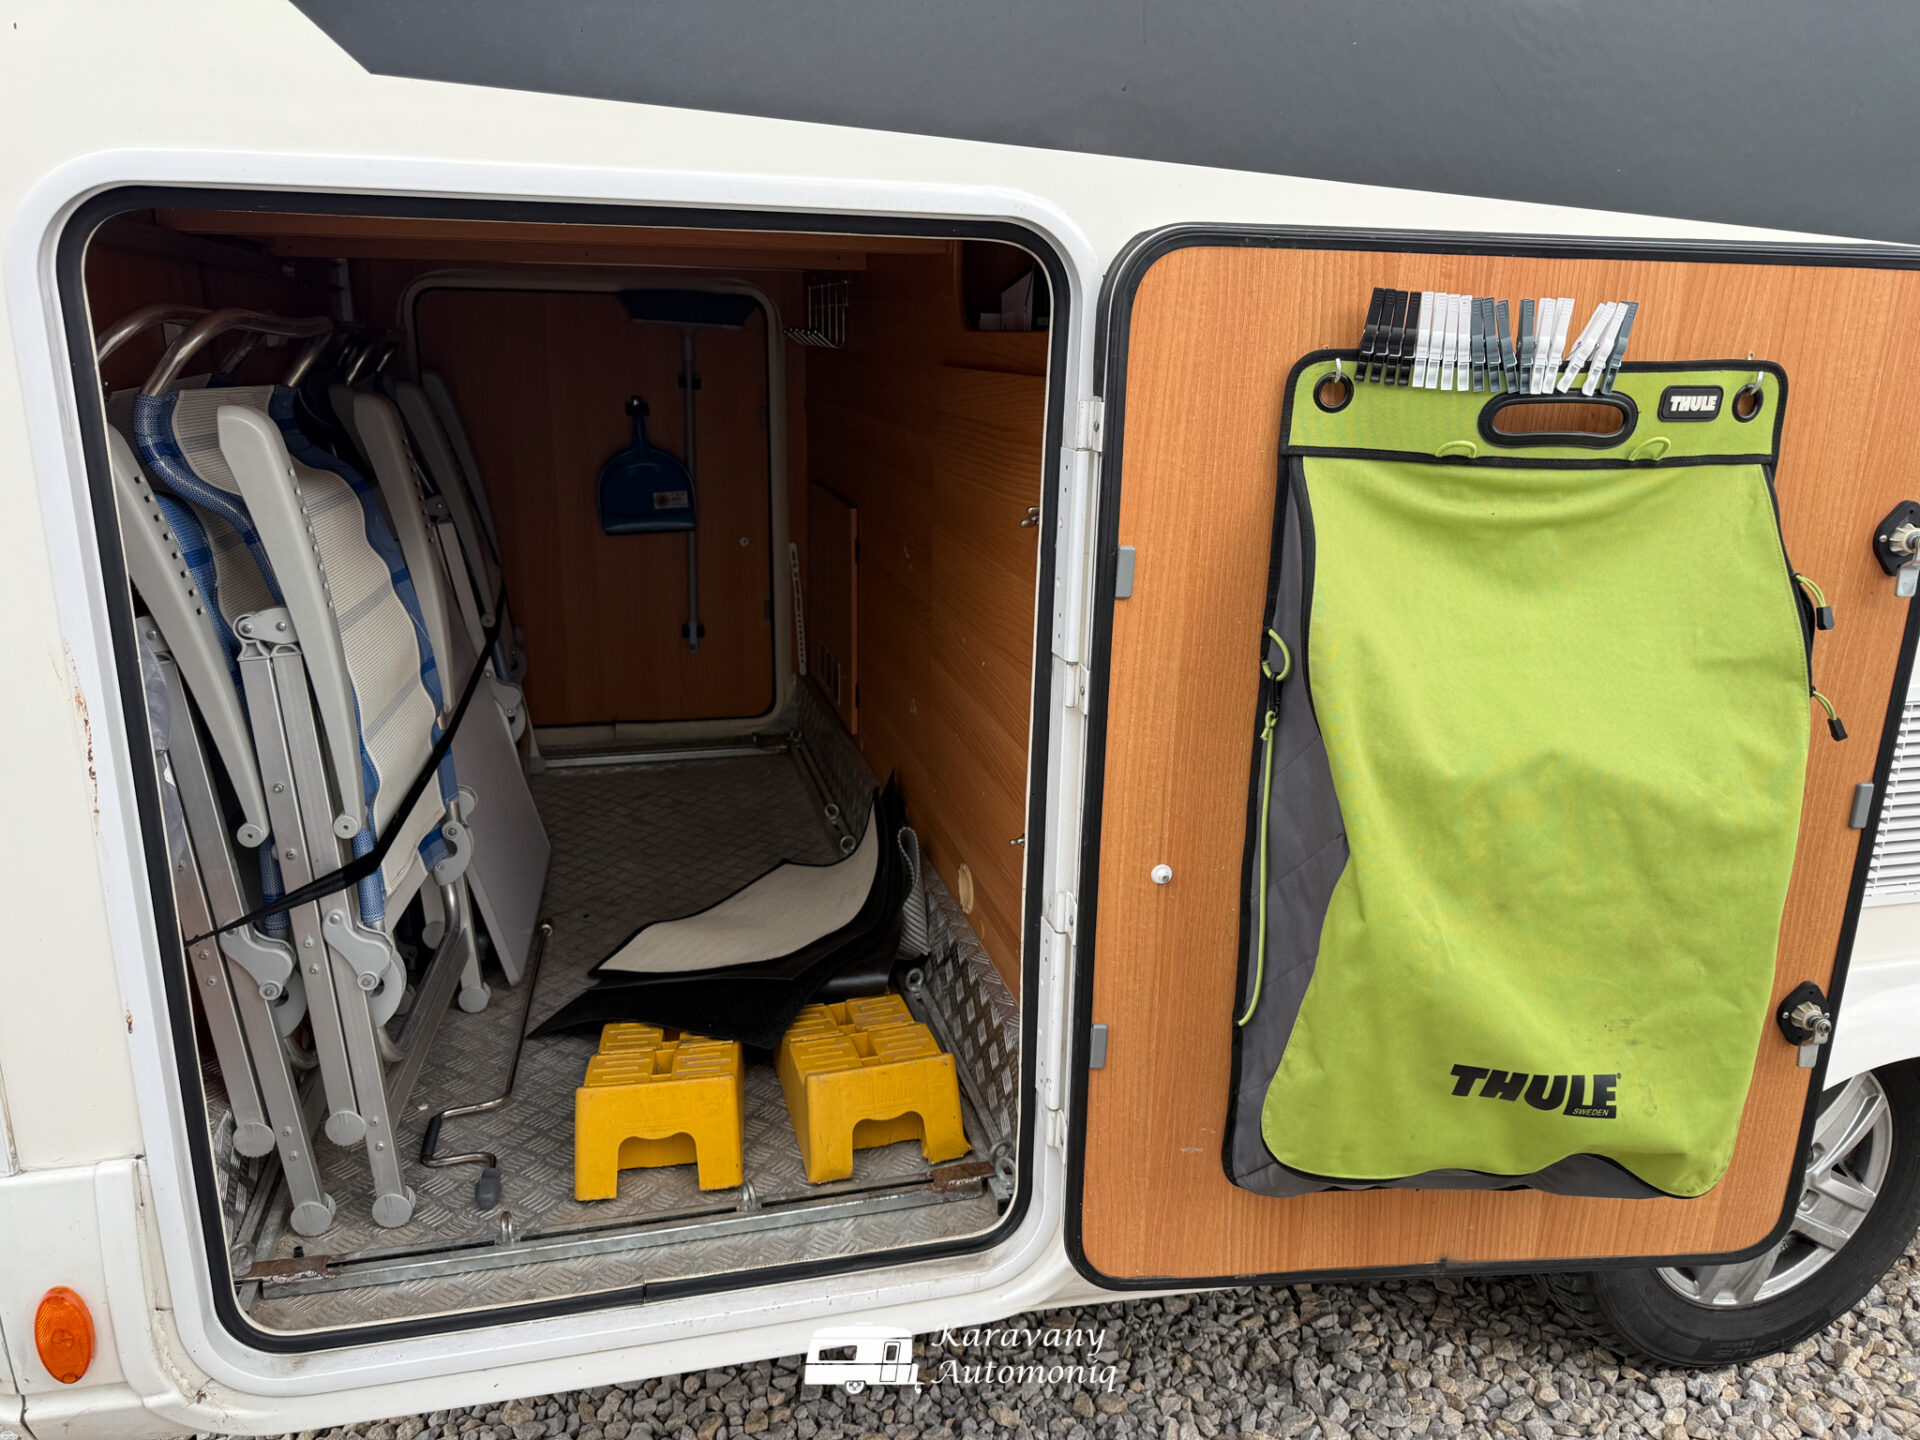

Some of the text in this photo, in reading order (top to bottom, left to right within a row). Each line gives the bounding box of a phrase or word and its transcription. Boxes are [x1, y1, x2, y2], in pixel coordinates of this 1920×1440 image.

[1670, 395, 1718, 412] THULE
[1450, 1064, 1617, 1119] THULE
[1572, 1108, 1609, 1117] SWEDEN
